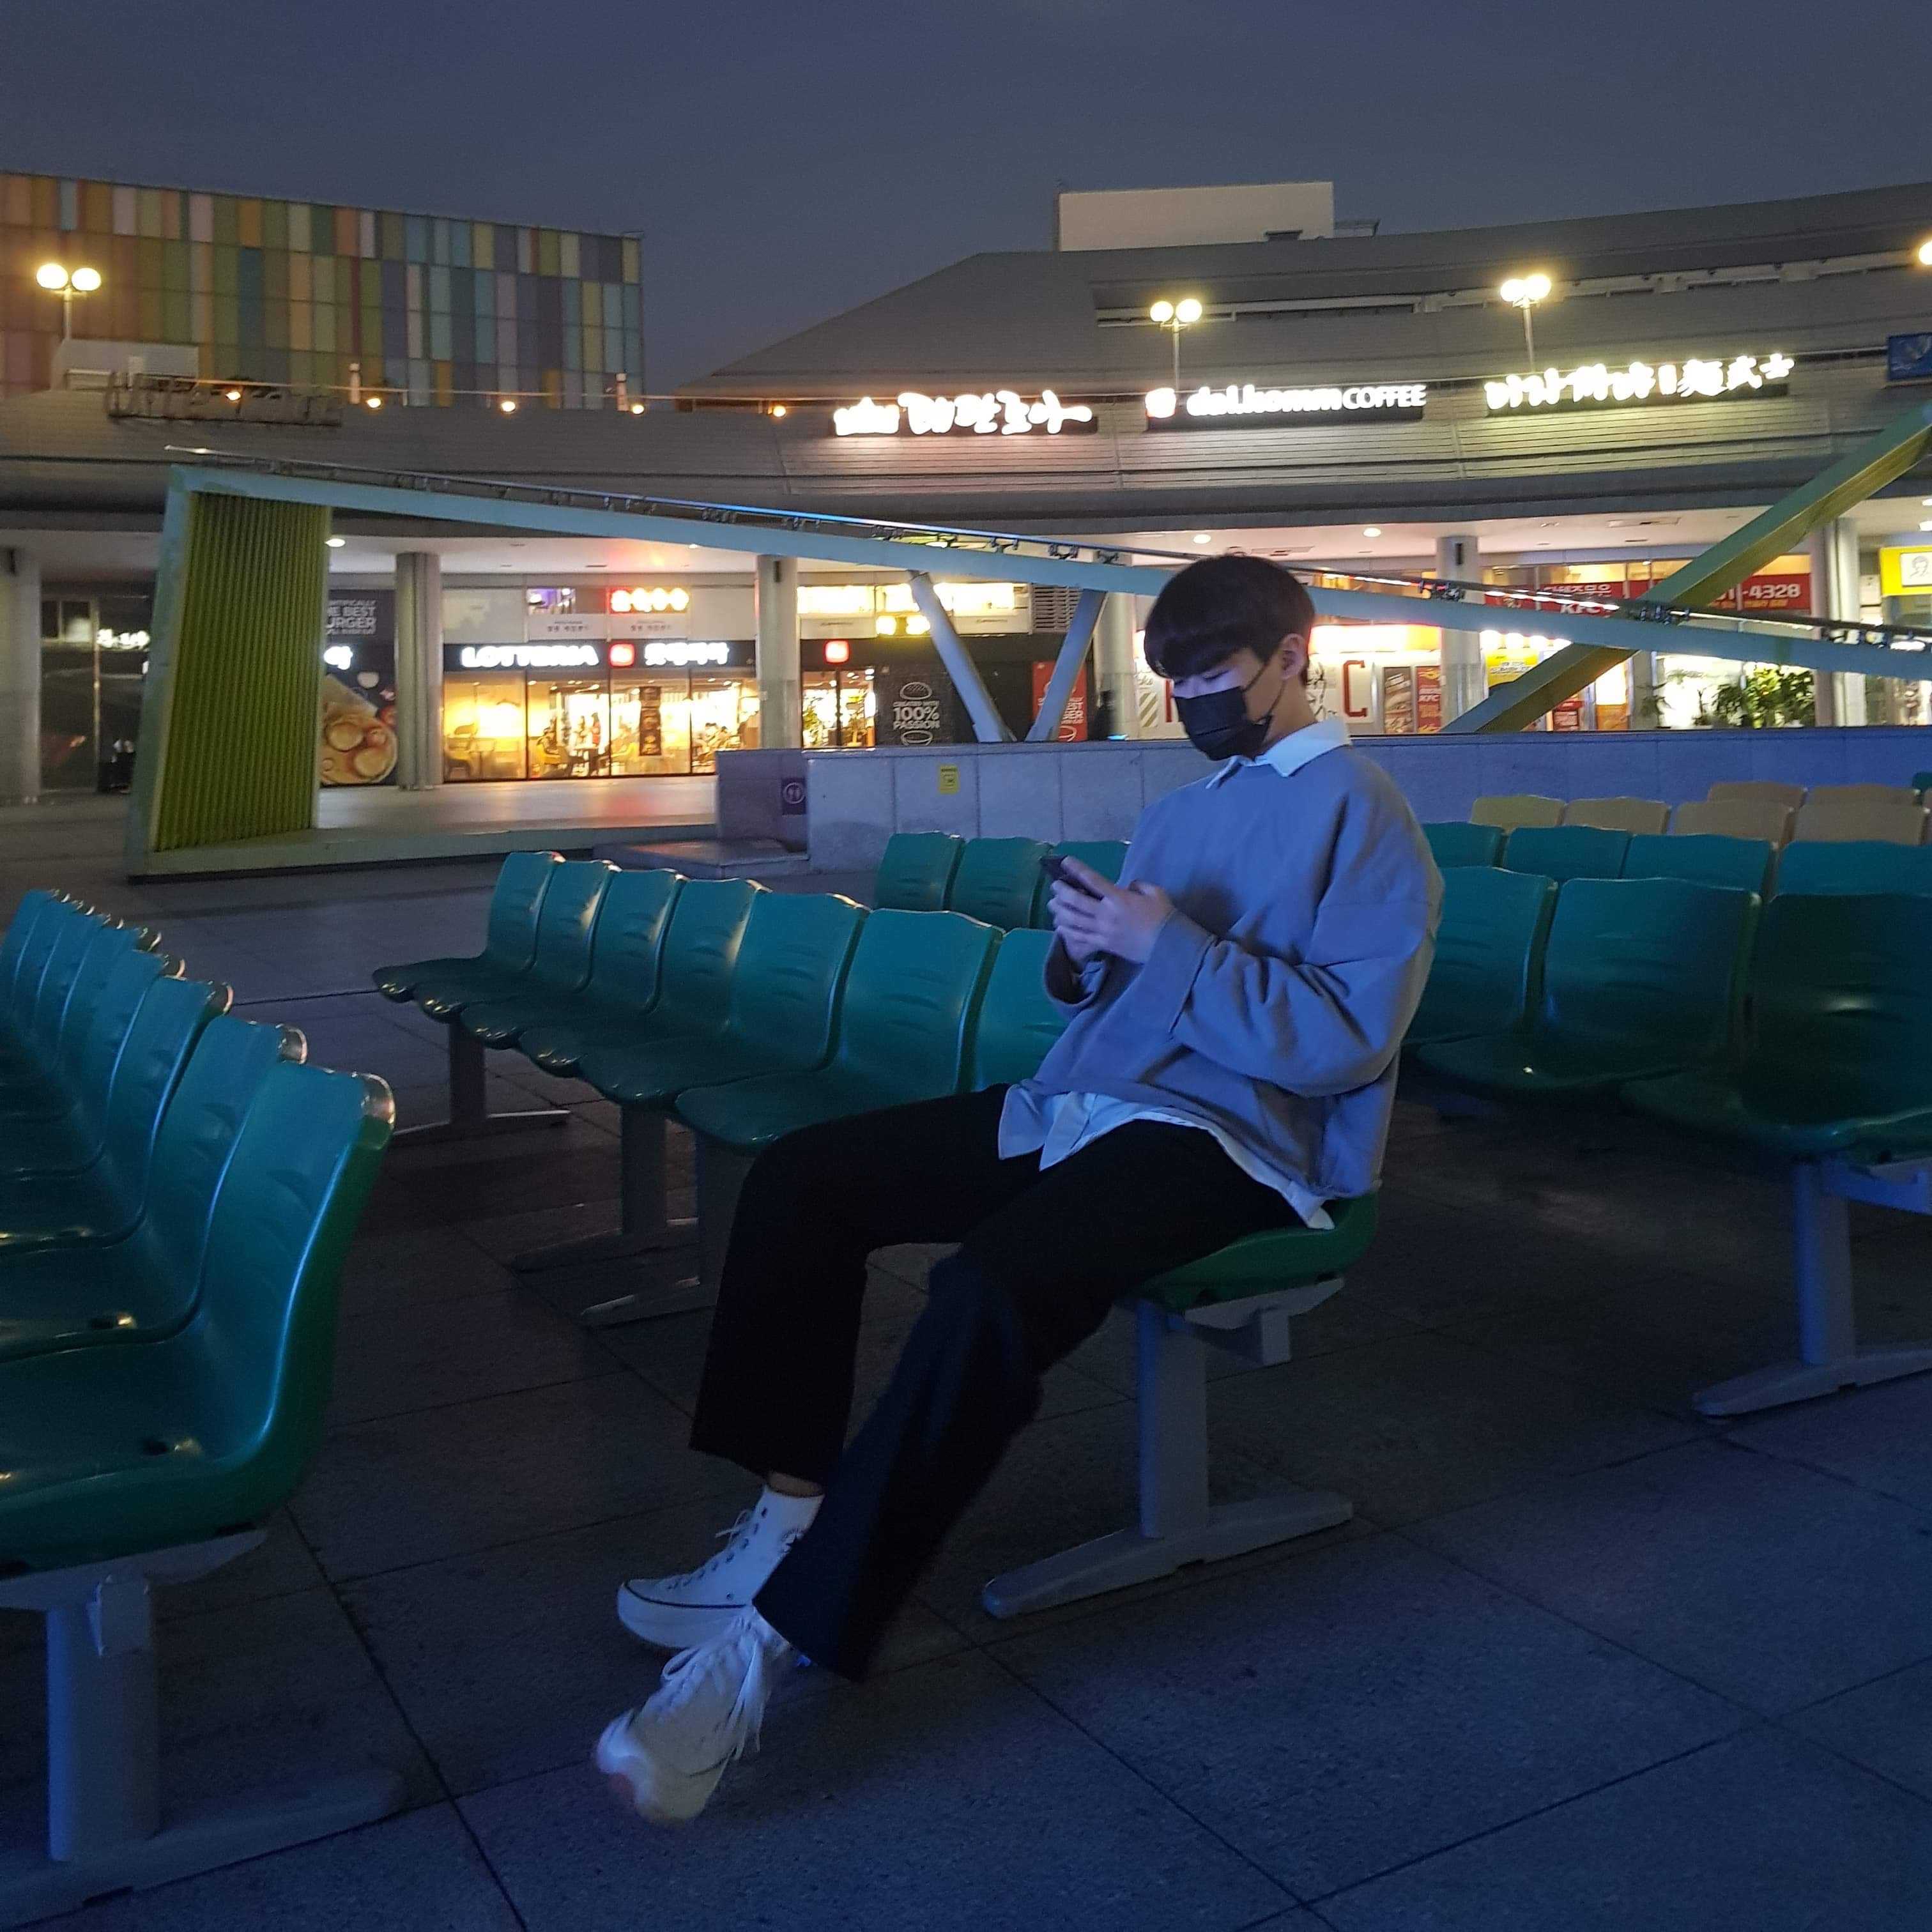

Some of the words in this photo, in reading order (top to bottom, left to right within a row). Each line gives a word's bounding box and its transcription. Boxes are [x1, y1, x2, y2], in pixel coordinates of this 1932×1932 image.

[1343, 385, 1426, 410] COFFEE
[325, 617, 376, 628] URGER
[461, 645, 599, 667] LOTTERIA
[893, 706, 940, 721] 100%
